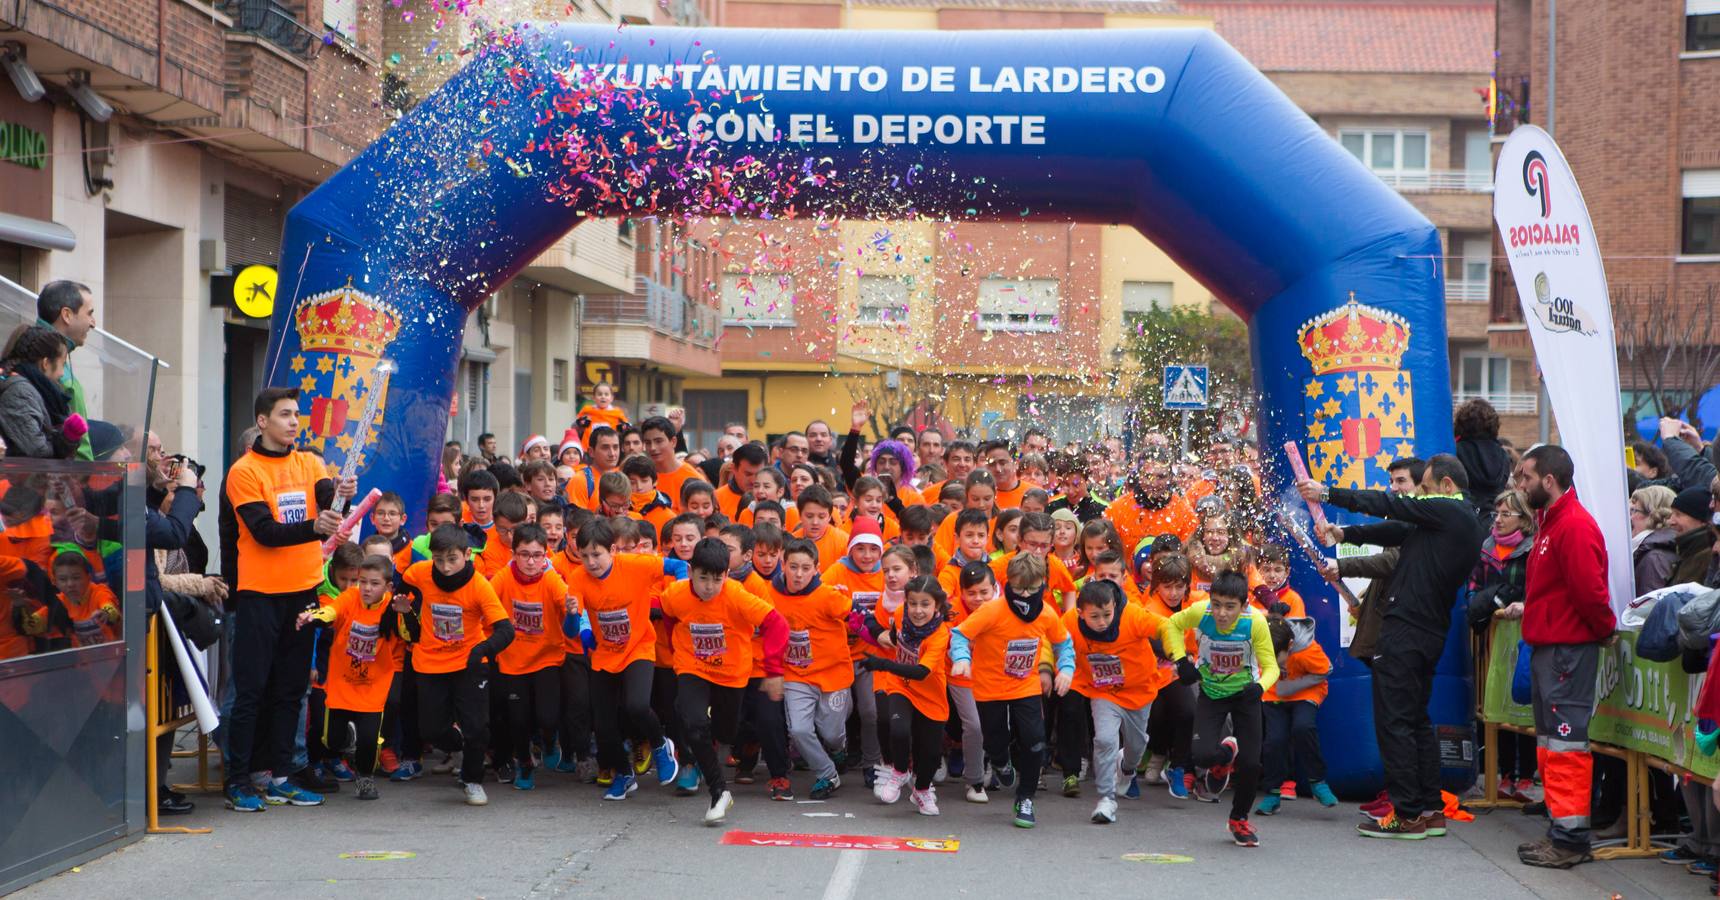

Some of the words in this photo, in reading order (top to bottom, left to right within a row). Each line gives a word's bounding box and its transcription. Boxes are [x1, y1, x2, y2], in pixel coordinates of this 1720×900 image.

[566, 63, 888, 93] AYUNTAMIENTO
[901, 66, 955, 92] DE
[969, 66, 1166, 94] LARDERO
[686, 113, 775, 144] CON
[790, 114, 839, 143] EL
[853, 115, 1046, 145] DEPORTE
[601, 622, 629, 637] 249
[350, 636, 374, 655] 375
[695, 636, 723, 650] 280
[1008, 653, 1034, 670] 226
[1214, 654, 1241, 668] 190
